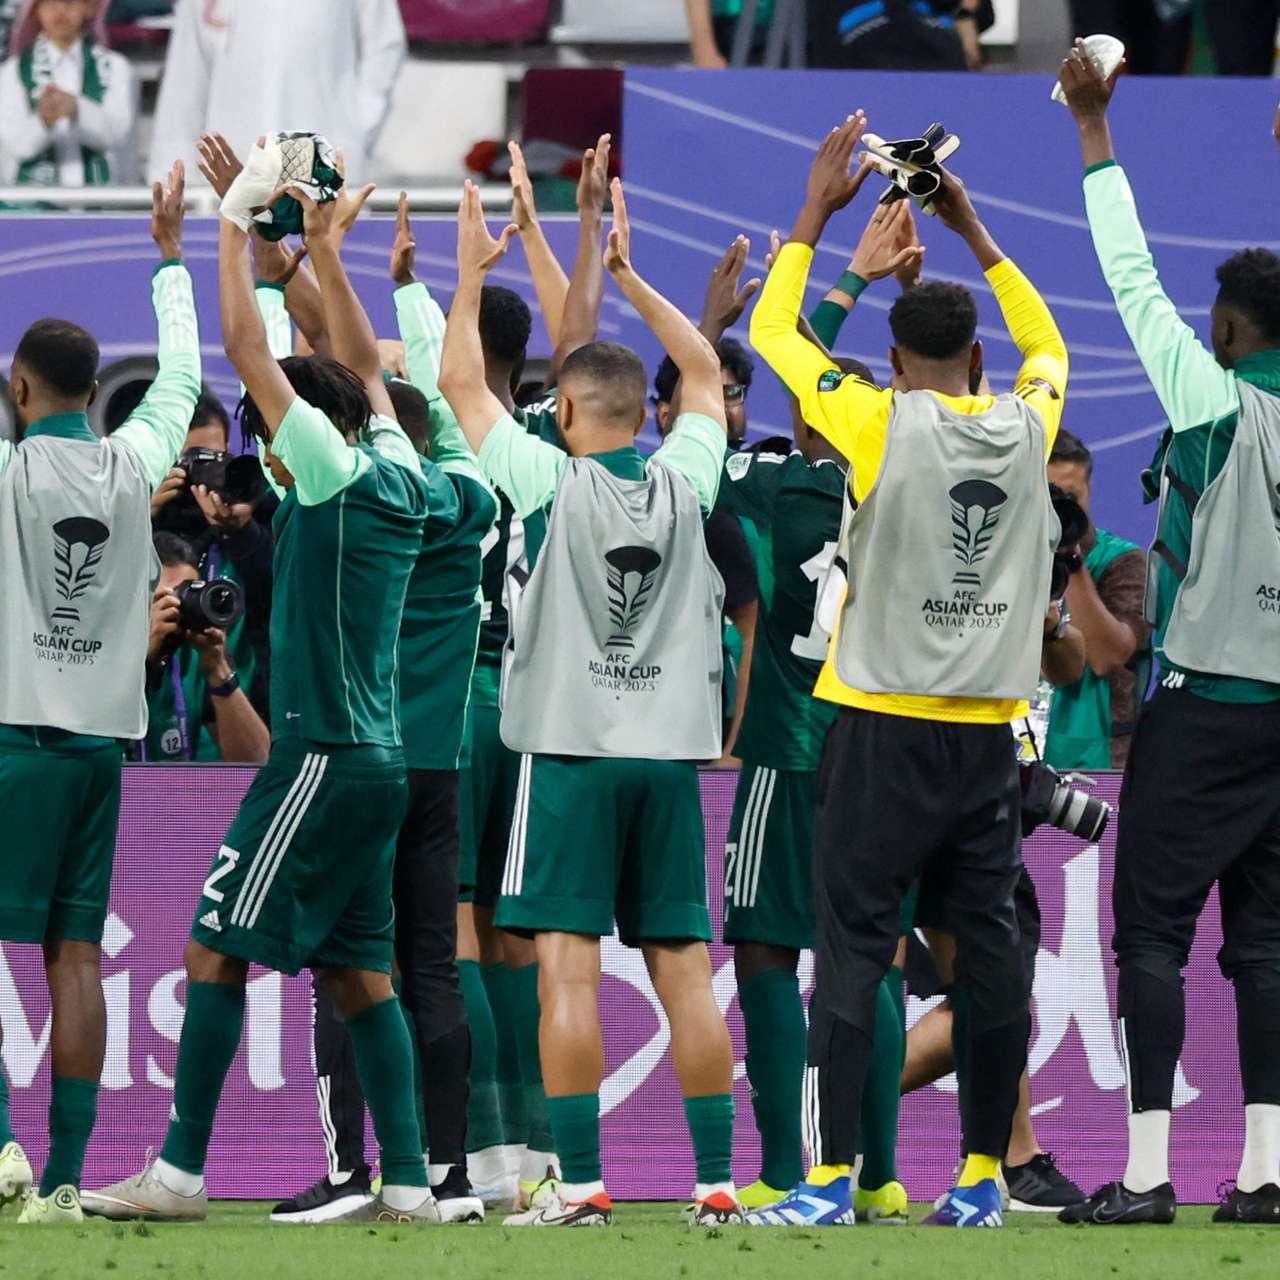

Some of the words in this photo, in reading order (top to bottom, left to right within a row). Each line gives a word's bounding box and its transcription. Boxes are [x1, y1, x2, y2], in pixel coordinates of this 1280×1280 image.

[953, 590, 977, 601] AFC
[922, 598, 970, 616] ASIAN
[972, 603, 1008, 616] CUP
[924, 614, 965, 628] QATAR
[968, 617, 1001, 629] 2023
[51, 625, 75, 637] AFC
[71, 639, 102, 653] CUP
[606, 653, 631, 664] AFC
[588, 660, 626, 679] ASIAN
[629, 666, 662, 679] CUP
[165, 736, 179, 751] 12
